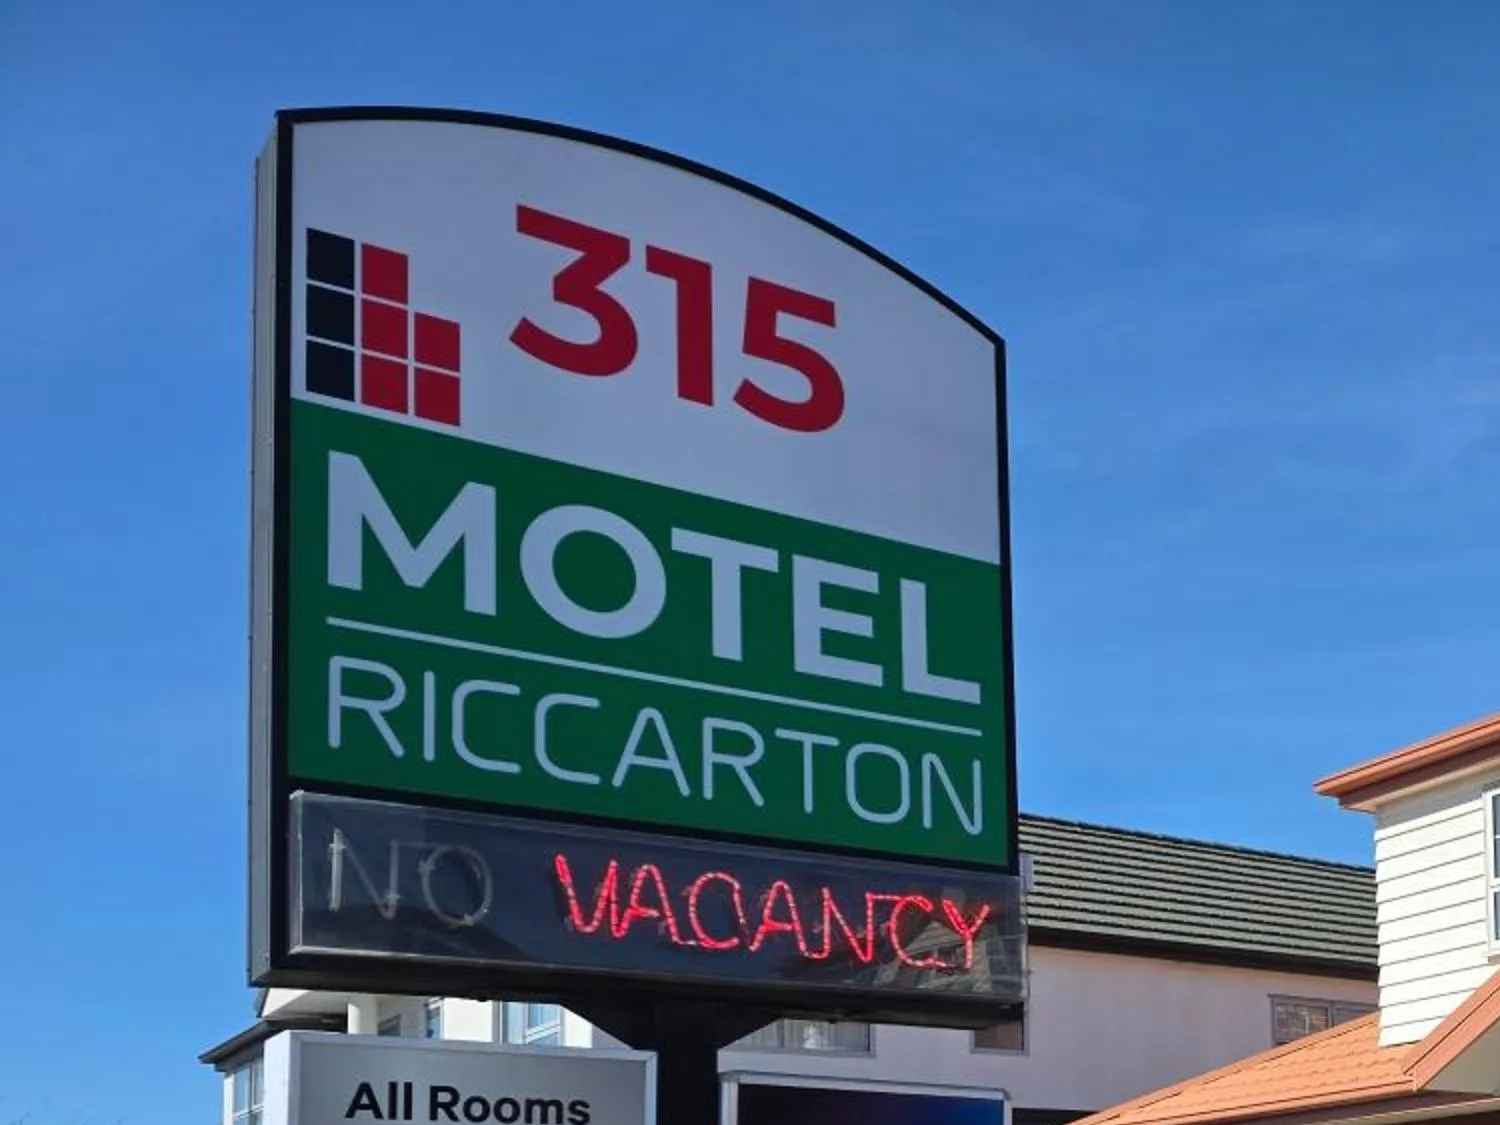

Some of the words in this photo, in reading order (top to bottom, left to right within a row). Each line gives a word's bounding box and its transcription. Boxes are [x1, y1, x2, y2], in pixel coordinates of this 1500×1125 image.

[509, 203, 846, 433] 315
[327, 450, 982, 705] MOTEL
[328, 655, 983, 836] RICCARTON
[328, 827, 494, 928] NO
[554, 853, 991, 971] VACANCY
[345, 1081, 414, 1122] All
